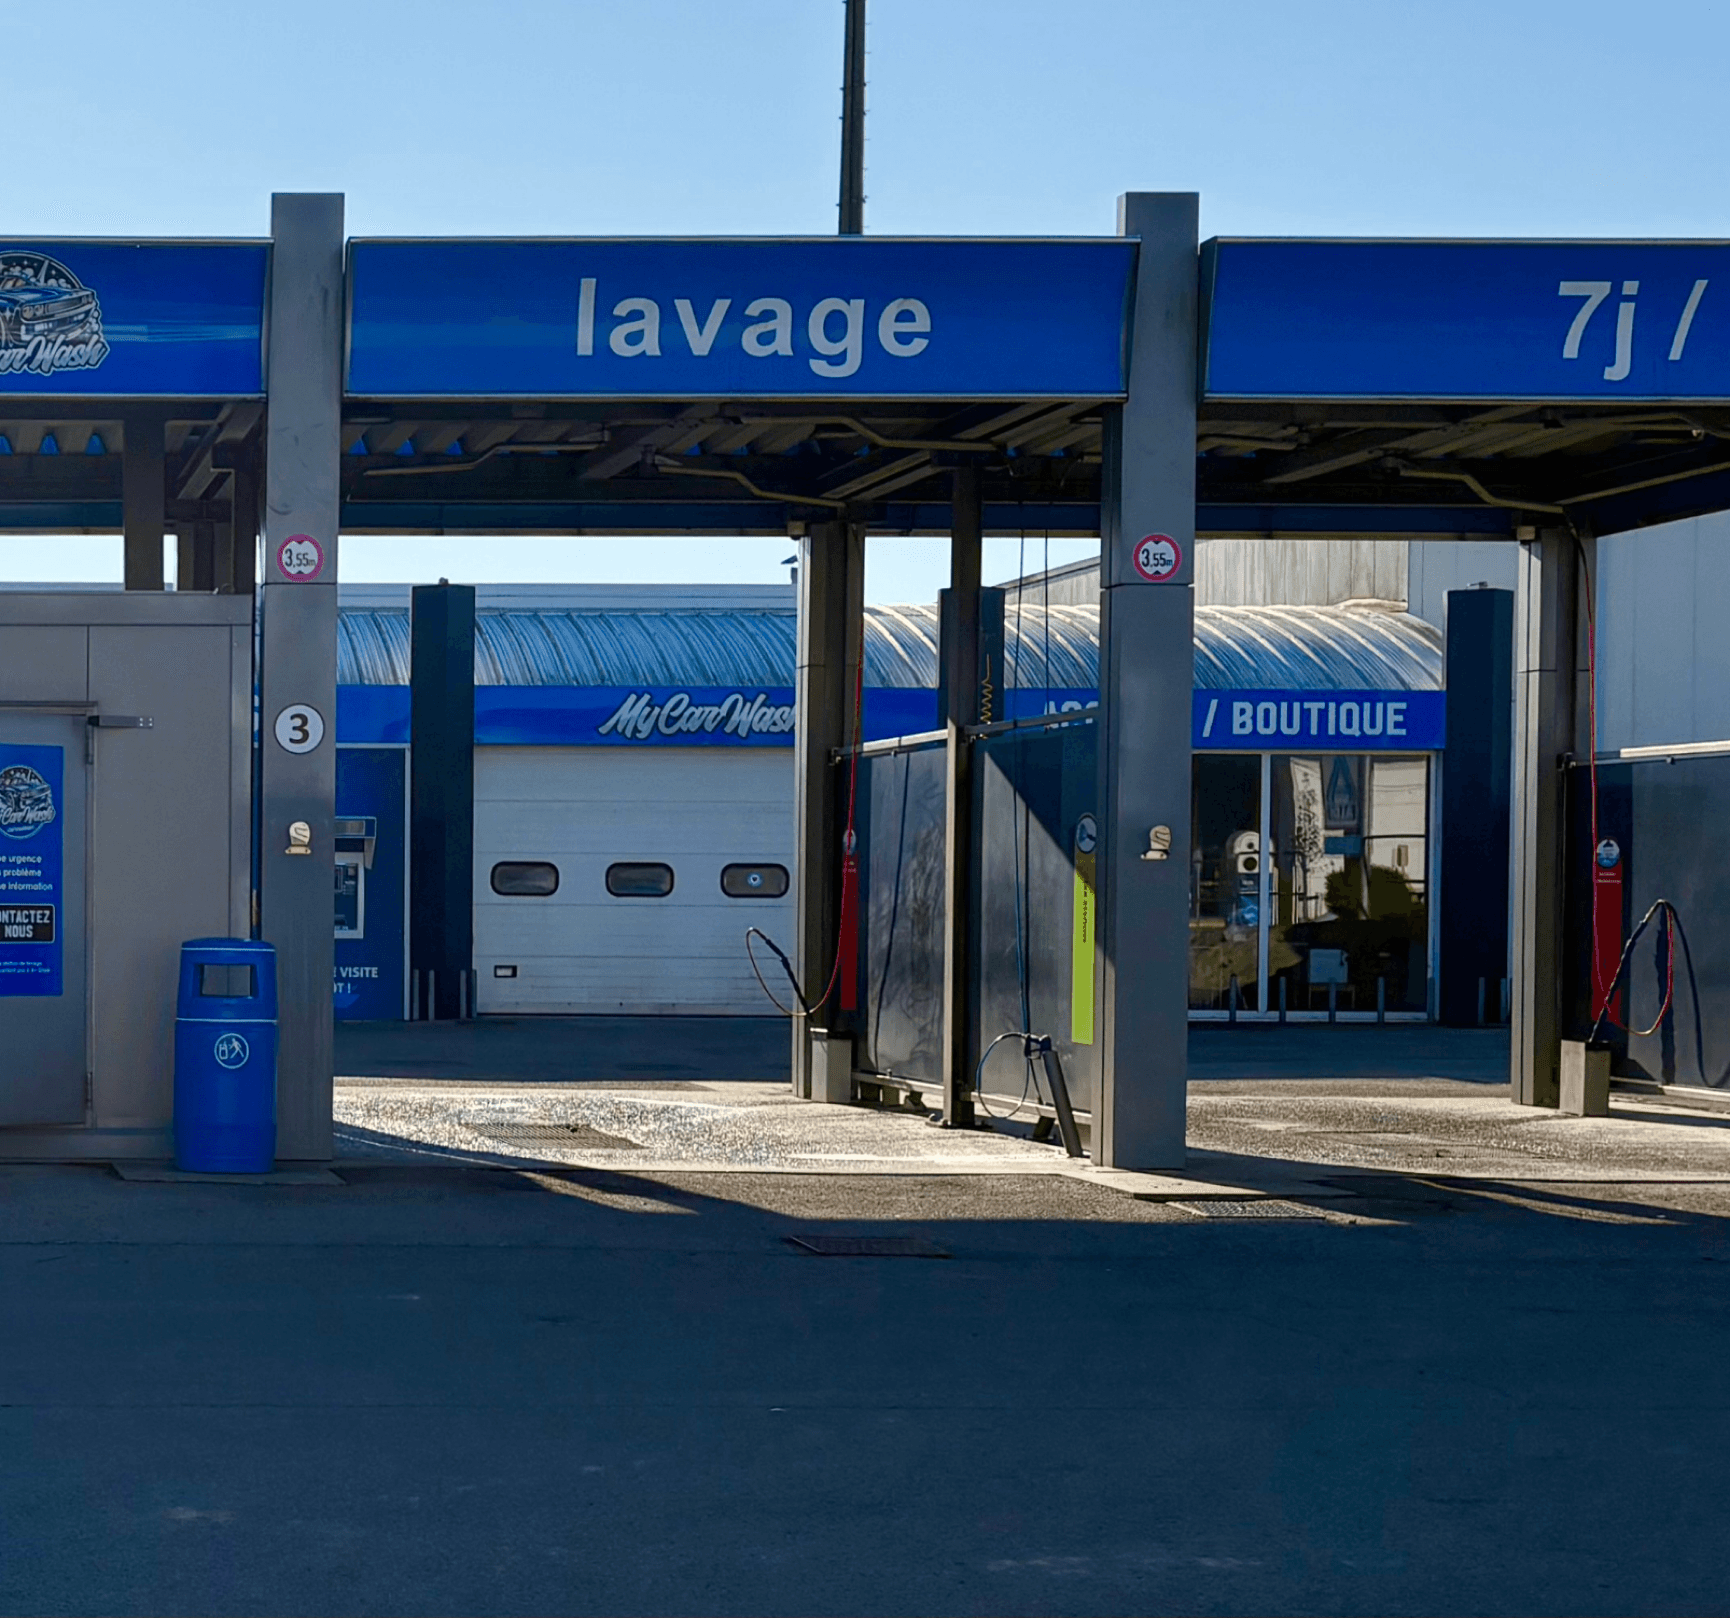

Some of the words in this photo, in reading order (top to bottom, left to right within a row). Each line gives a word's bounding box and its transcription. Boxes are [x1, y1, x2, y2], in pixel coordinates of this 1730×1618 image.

[576, 277, 932, 378] lavage
[1558, 280, 1640, 382] 7j
[1668, 279, 1710, 362] /
[1232, 701, 1408, 738] BOUTIQUE
[288, 712, 310, 745] 3
[8, 855, 42, 865] urgence
[2, 866, 42, 878] problème
[7, 881, 54, 891] information
[4, 924, 34, 938] NOUS
[339, 966, 379, 978] VISITE
